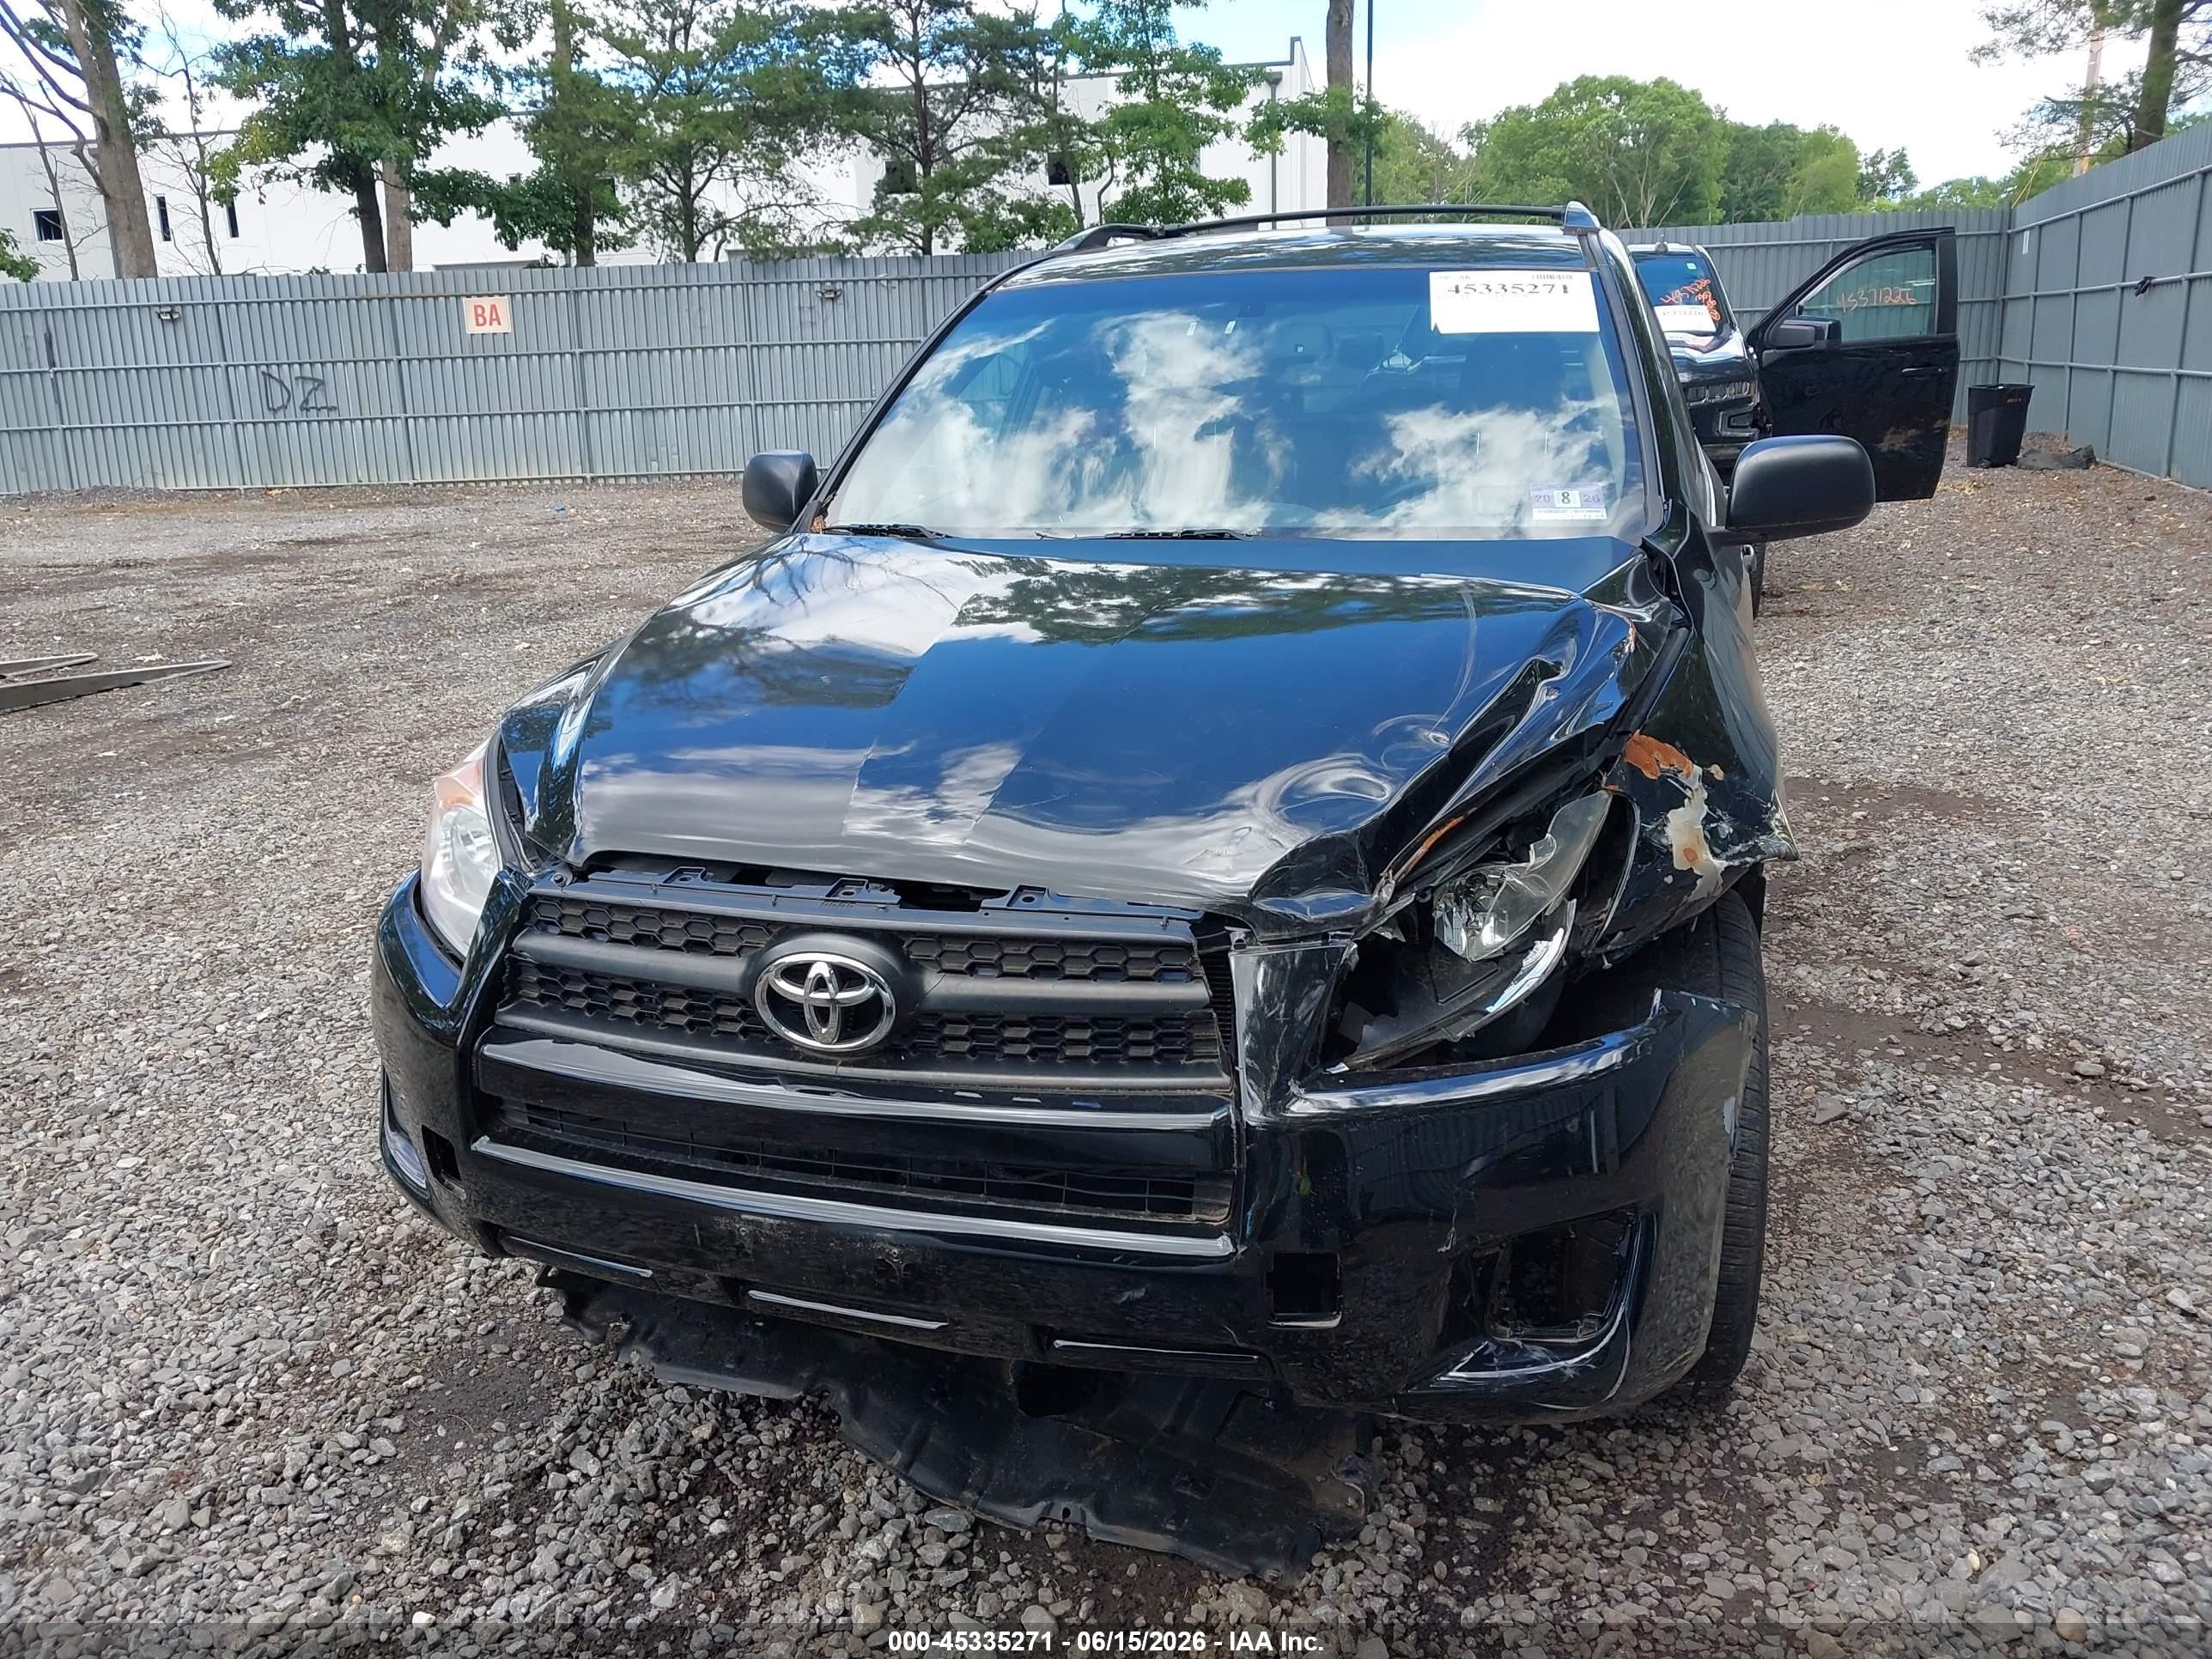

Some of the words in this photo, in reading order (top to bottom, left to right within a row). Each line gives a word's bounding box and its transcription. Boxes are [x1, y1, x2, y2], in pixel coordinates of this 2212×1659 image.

[1448, 283, 1570, 295] 45335271
[473, 304, 501, 327] BA
[1534, 494, 1551, 502] 20
[1561, 491, 1571, 505] 8
[1583, 494, 1601, 503] 26
